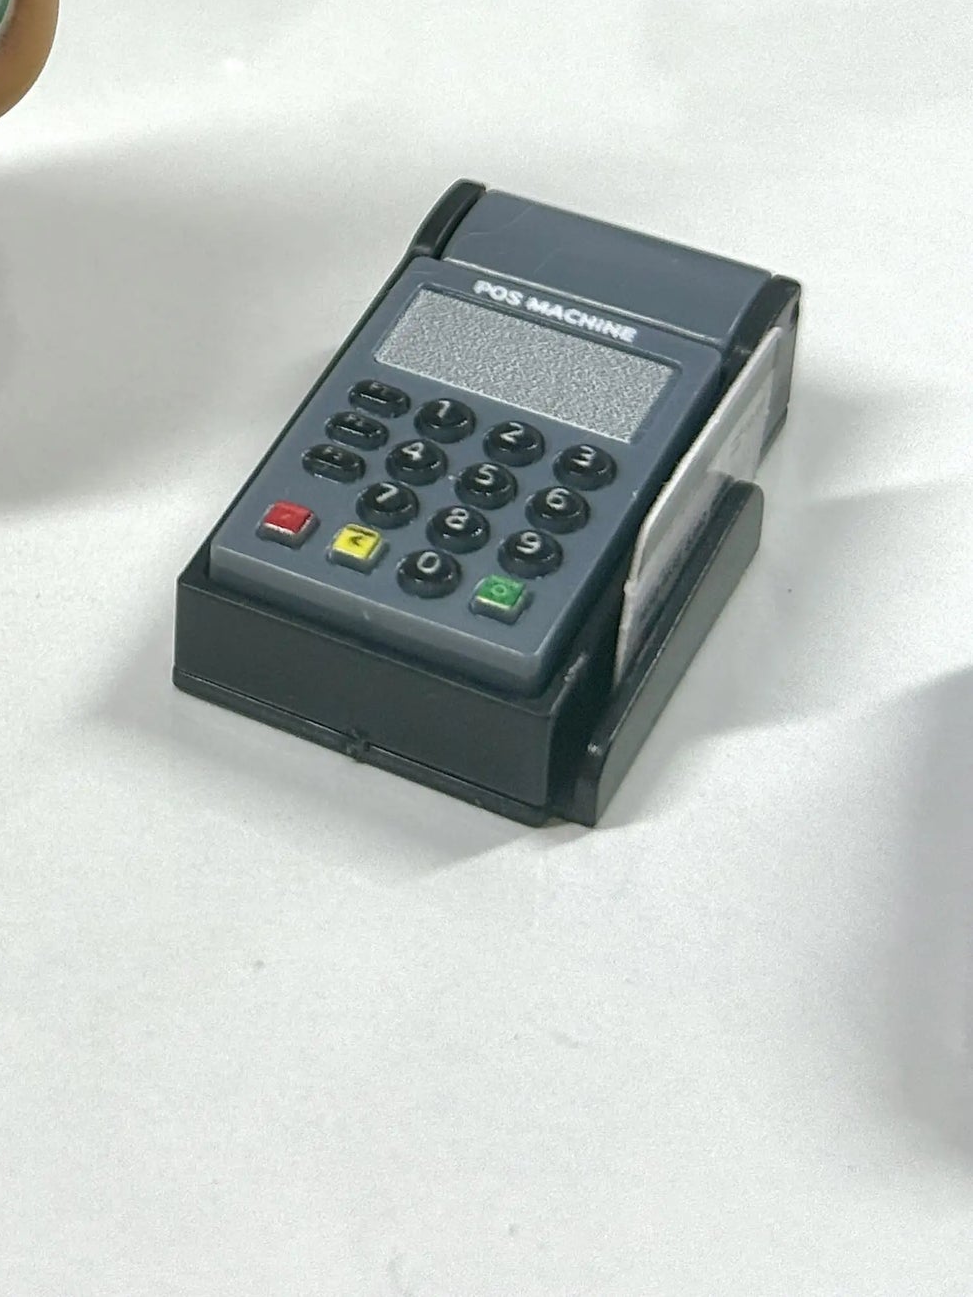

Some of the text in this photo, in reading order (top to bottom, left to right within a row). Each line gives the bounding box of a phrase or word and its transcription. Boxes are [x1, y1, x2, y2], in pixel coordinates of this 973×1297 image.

[473, 280, 637, 343] POS MACHINE
[438, 400, 596, 467] 1 2 3
[401, 442, 570, 510] 4 5 6
[376, 482, 542, 554] 7 8 9
[416, 551, 442, 574] 0
